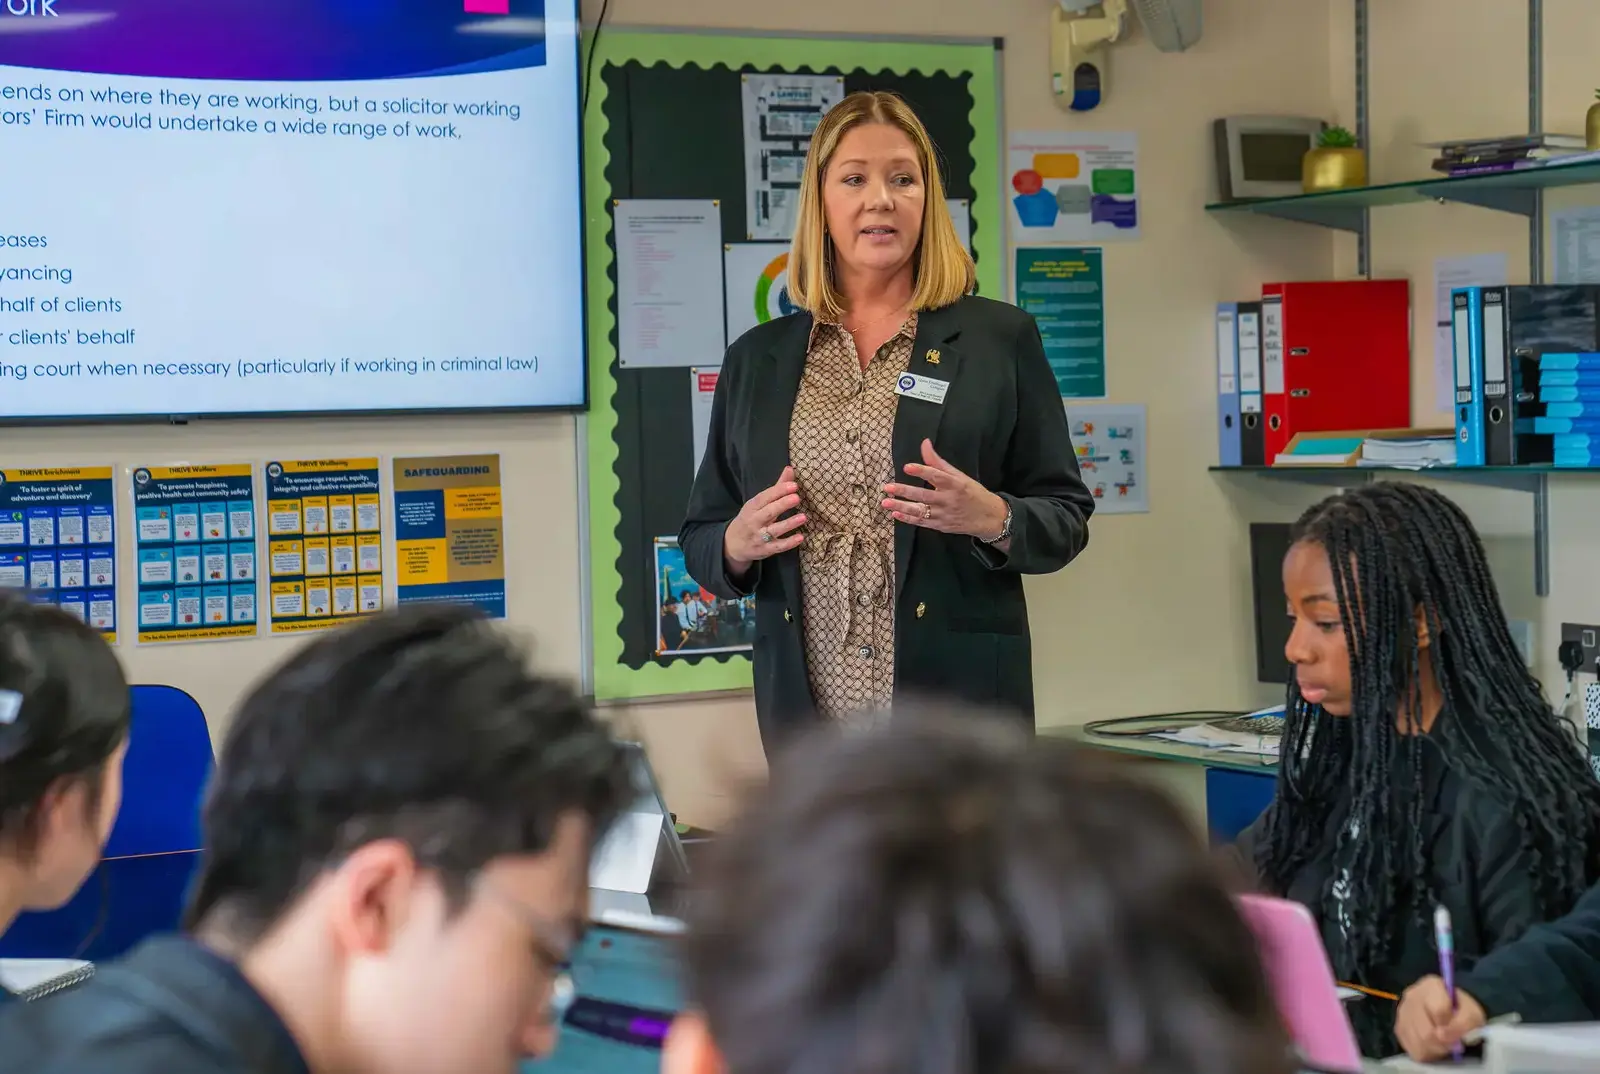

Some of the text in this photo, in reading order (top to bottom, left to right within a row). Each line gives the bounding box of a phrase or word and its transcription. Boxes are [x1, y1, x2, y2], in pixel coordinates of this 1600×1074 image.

[0, 0, 59, 17] ork
[0, 83, 521, 122] ends on where they are working, but a solicitor working
[0, 108, 463, 141] ors' Firm would undertake a wide range of work,
[40, 296, 60, 313] of
[65, 296, 122, 313] clients
[9, 328, 71, 346] clients'
[77, 328, 136, 345] behalf
[33, 360, 83, 377] court
[87, 360, 138, 376] when
[144, 362, 232, 381] necessary
[237, 358, 337, 378] (particularly
[341, 357, 351, 373] if
[354, 356, 418, 376] working
[423, 356, 436, 372] in
[440, 355, 502, 372] criminal
[506, 355, 539, 375] law)
[404, 465, 490, 478] SAFEGUARDING
[168, 482, 195, 491] promote
[273, 484, 299, 493] integrity
[312, 483, 339, 491] collective
[294, 476, 325, 485] encourage
[31, 485, 50, 493] foster
[57, 484, 74, 493] spirit
[137, 491, 161, 501] positive
[162, 490, 181, 498] health
[196, 488, 229, 498] community
